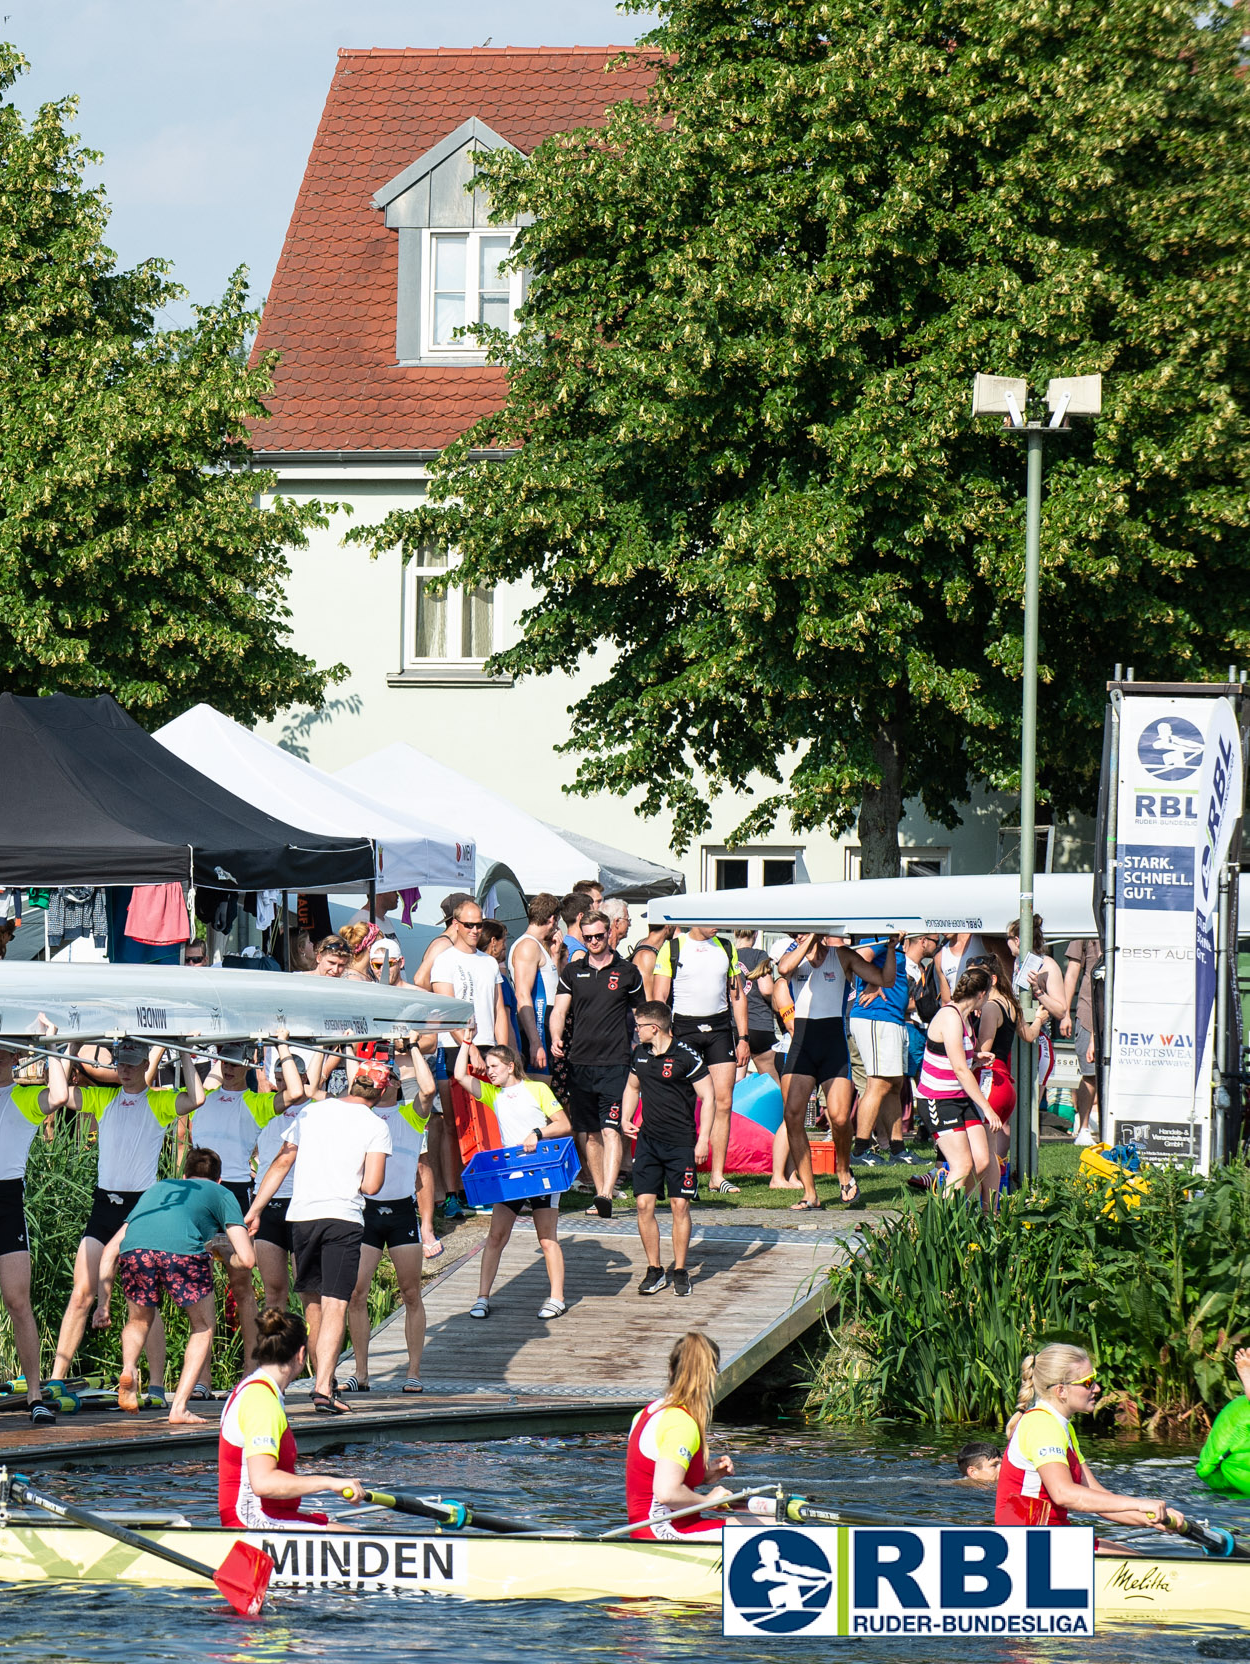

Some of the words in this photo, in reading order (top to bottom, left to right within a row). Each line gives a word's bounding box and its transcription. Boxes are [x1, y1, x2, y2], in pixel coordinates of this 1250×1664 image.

[1135, 795, 1198, 819] RBL
[1123, 856, 1174, 870] STARK.
[1123, 871, 1193, 886] SCHNELL.
[1123, 887, 1156, 900] GUT.
[1122, 948, 1160, 958] BEST
[136, 1006, 168, 1030] MINDEN
[1164, 1140, 1184, 1148] GmbH
[261, 1539, 454, 1580] MINDEN
[1104, 1560, 1173, 1594] Melitta
